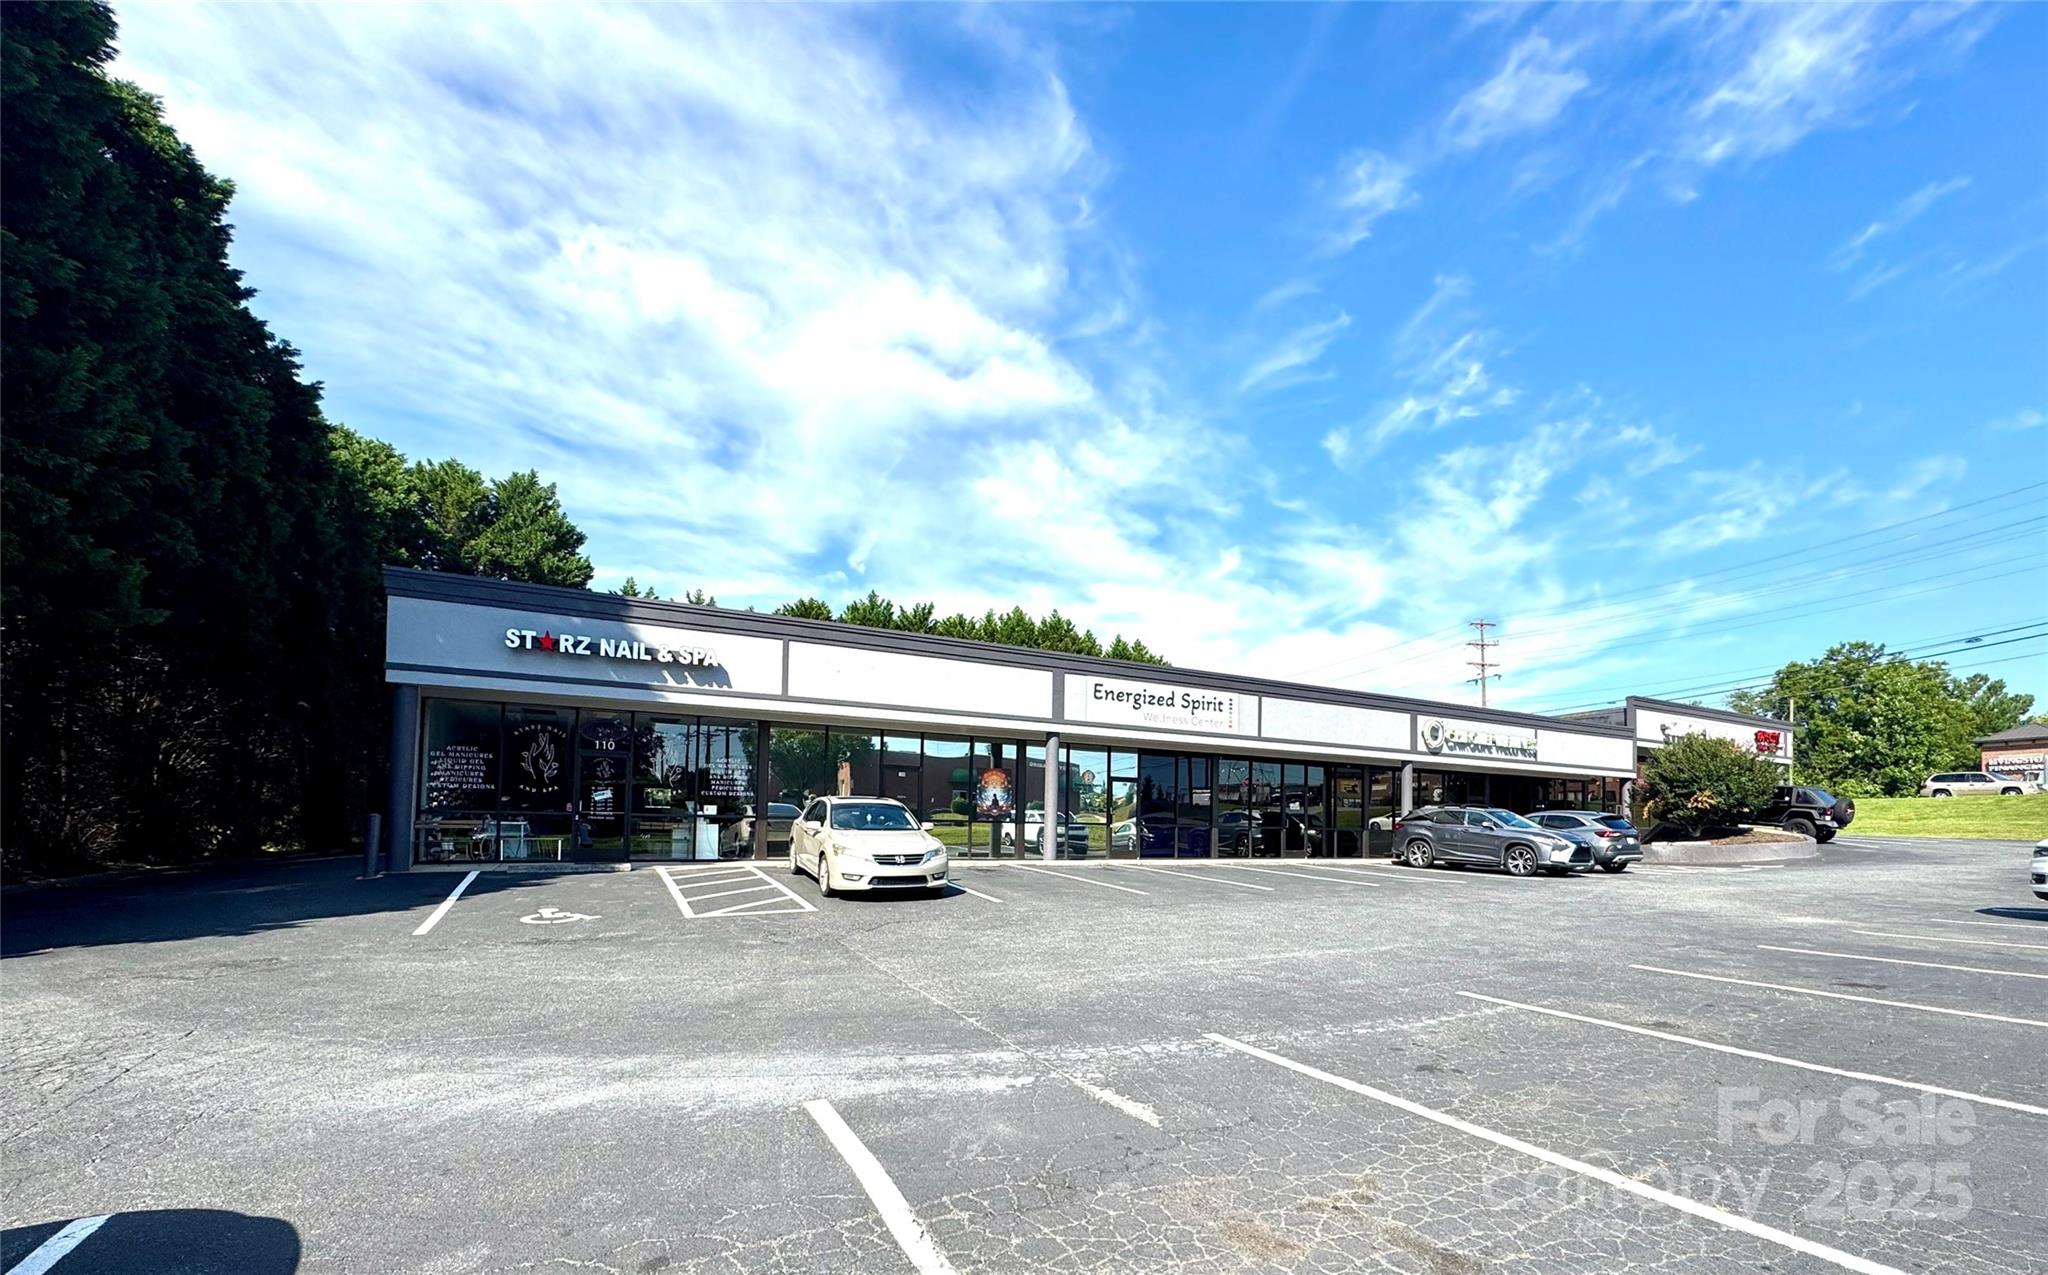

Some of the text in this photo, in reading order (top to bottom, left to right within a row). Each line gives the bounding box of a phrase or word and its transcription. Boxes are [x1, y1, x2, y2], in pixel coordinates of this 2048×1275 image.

[600, 638, 652, 661] NAIL
[657, 644, 673, 663] &
[678, 645, 719, 667] SPA
[1093, 683, 1224, 716] Energized Spirit
[594, 740, 616, 750] 110
[1988, 756, 2045, 766] LIVINGSTO
[1988, 763, 2045, 772] FINANCIA
